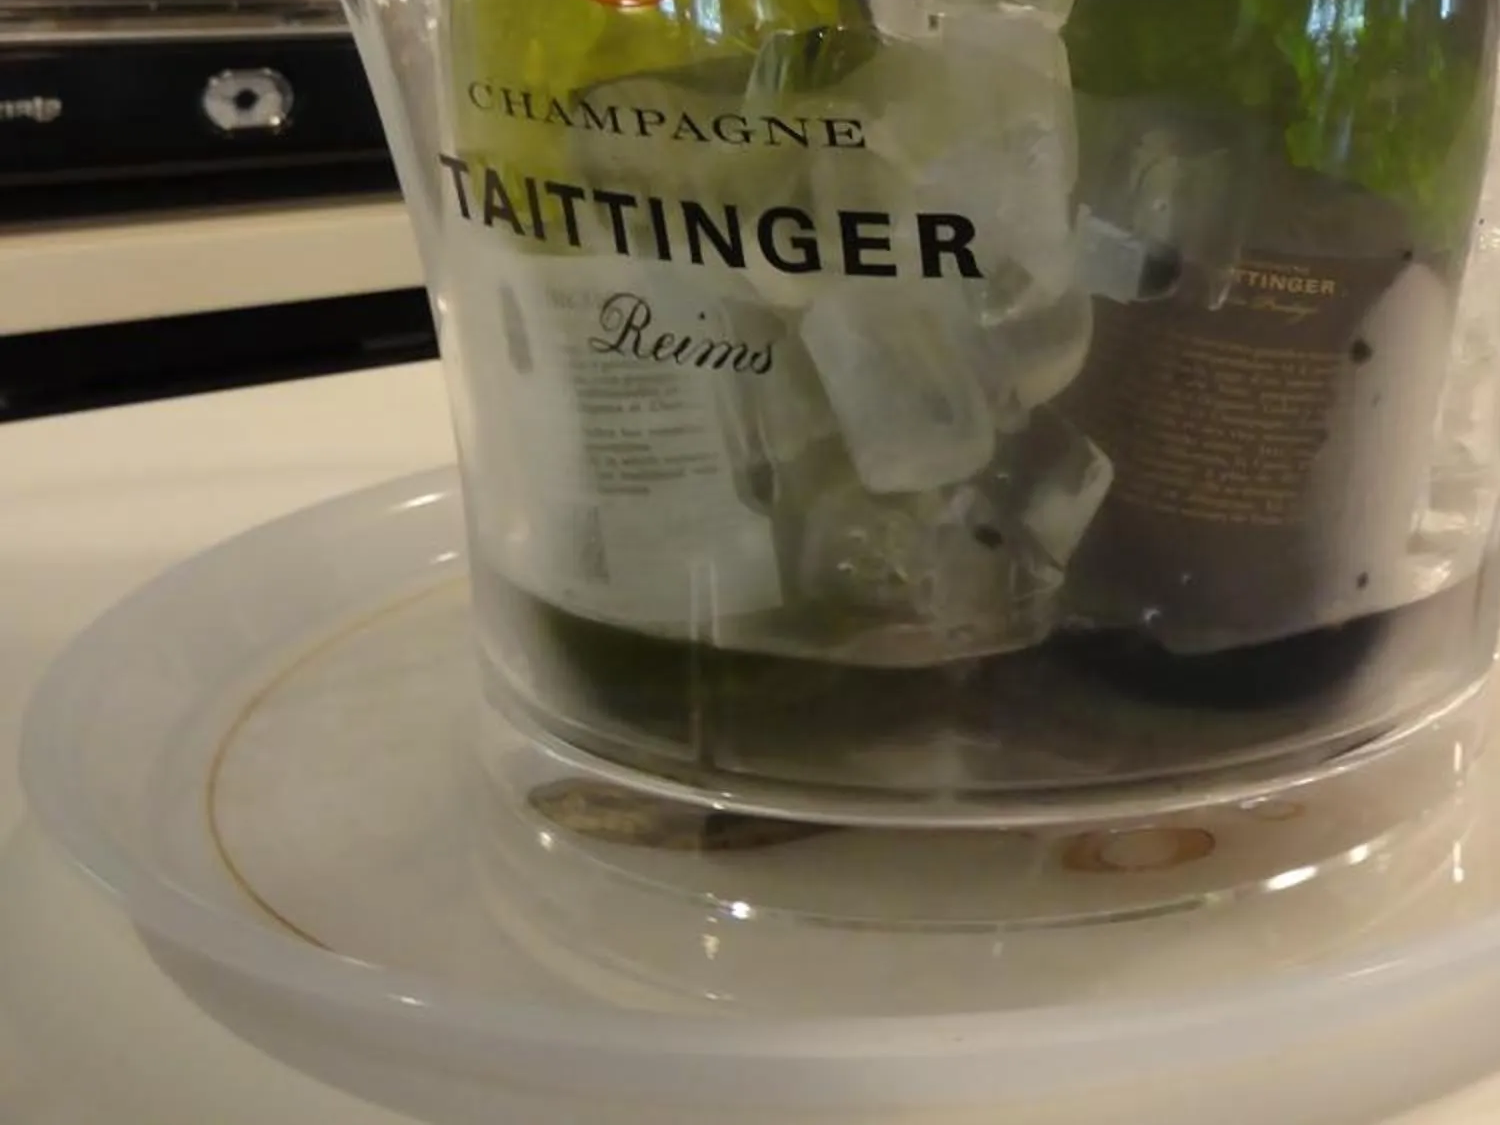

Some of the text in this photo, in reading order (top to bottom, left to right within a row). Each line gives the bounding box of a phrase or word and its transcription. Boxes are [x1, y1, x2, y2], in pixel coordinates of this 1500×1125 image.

[467, 81, 867, 149] CHAMPAGNE
[439, 153, 985, 279] TAITTINGER
[589, 292, 775, 375] Reims
